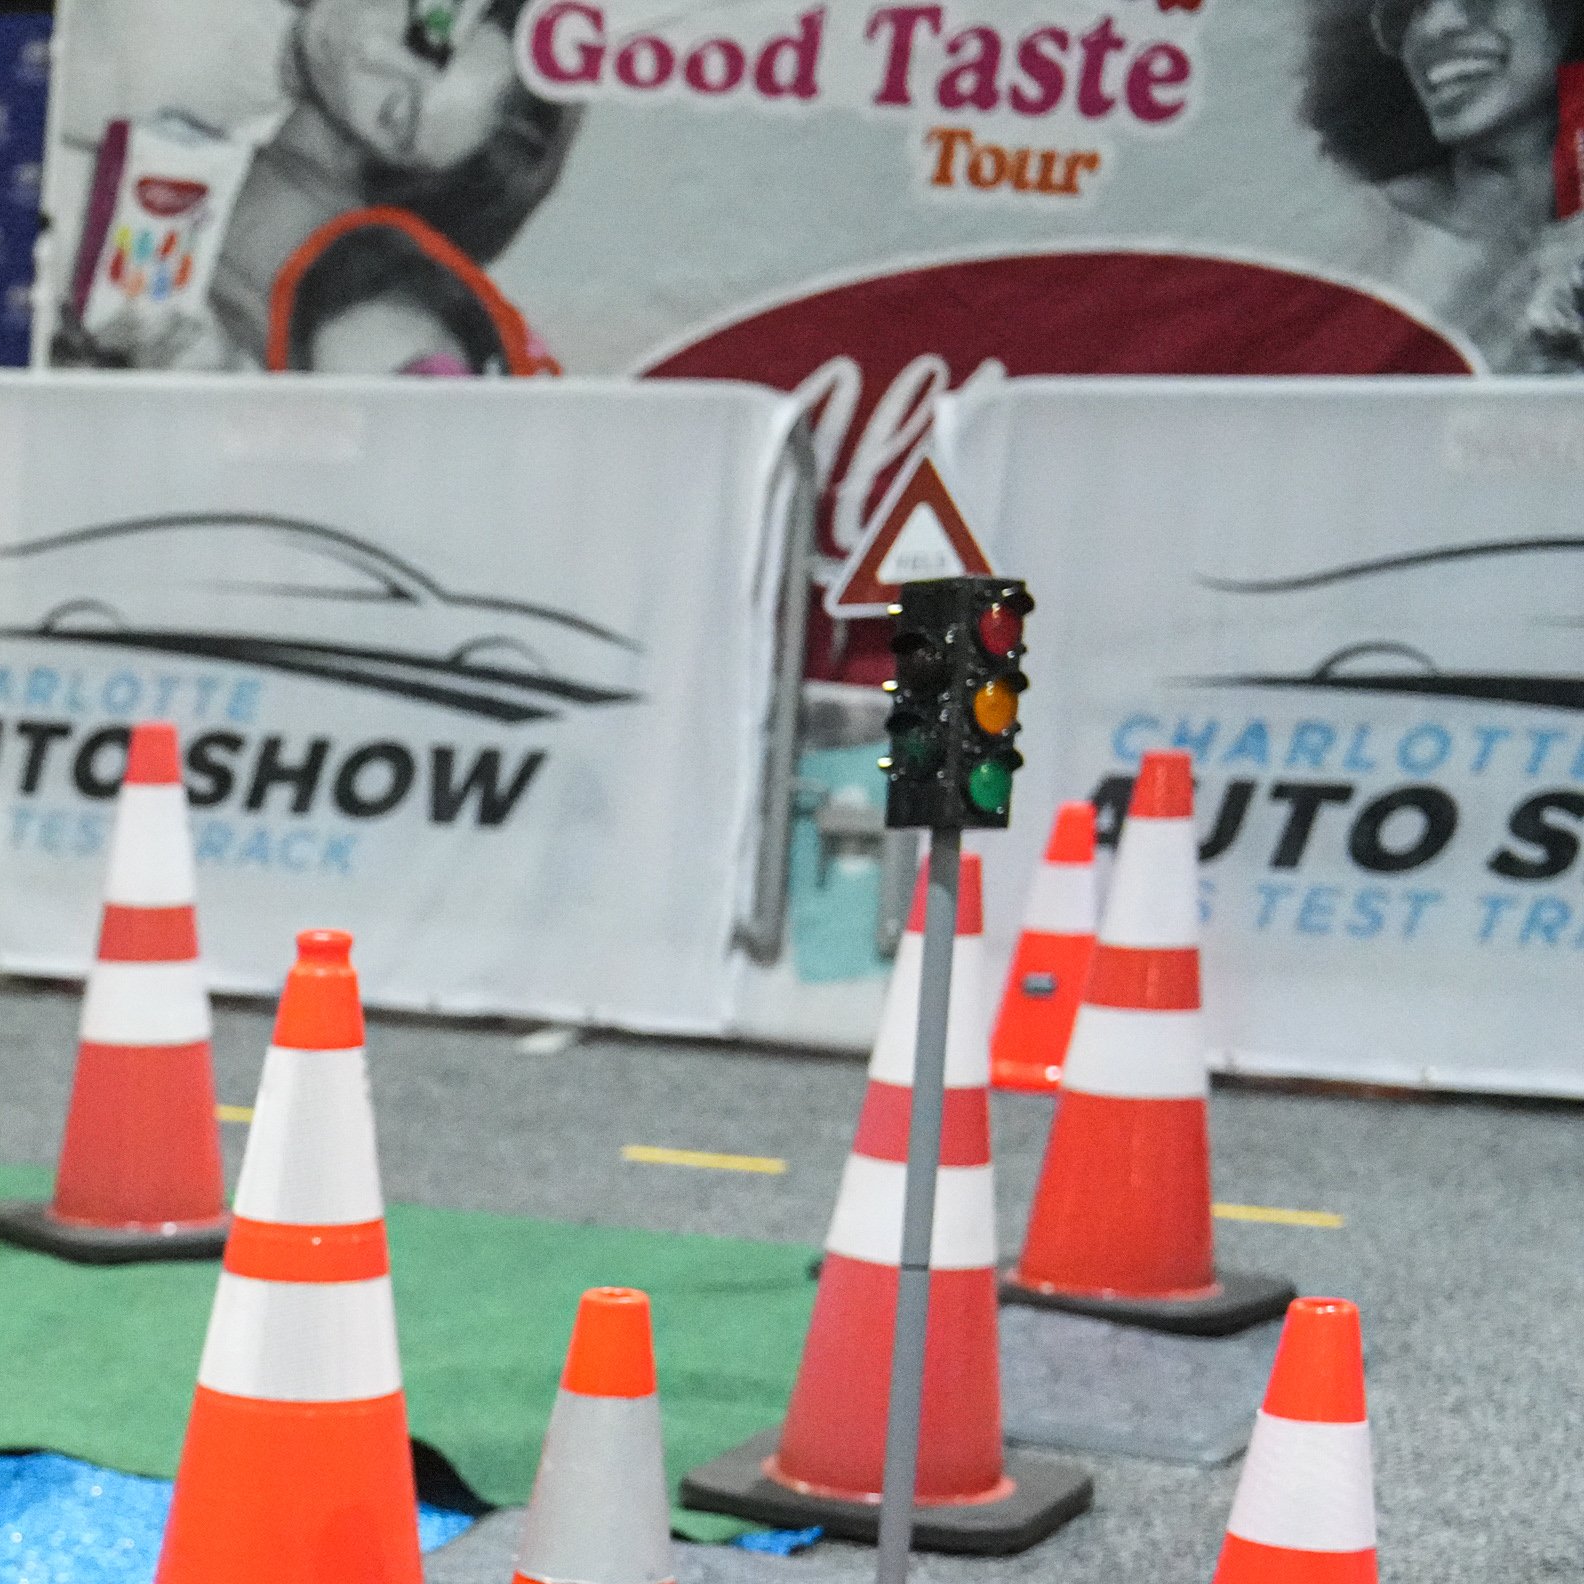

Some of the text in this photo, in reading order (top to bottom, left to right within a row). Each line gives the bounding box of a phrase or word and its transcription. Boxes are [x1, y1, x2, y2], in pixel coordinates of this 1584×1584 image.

[528, 2, 1194, 124] Good Taste
[926, 126, 1100, 197] Tour
[184, 730, 546, 829] SHOW
[9, 806, 110, 855] TES
[194, 820, 358, 873] RACK
[1255, 880, 1442, 941] TEST
